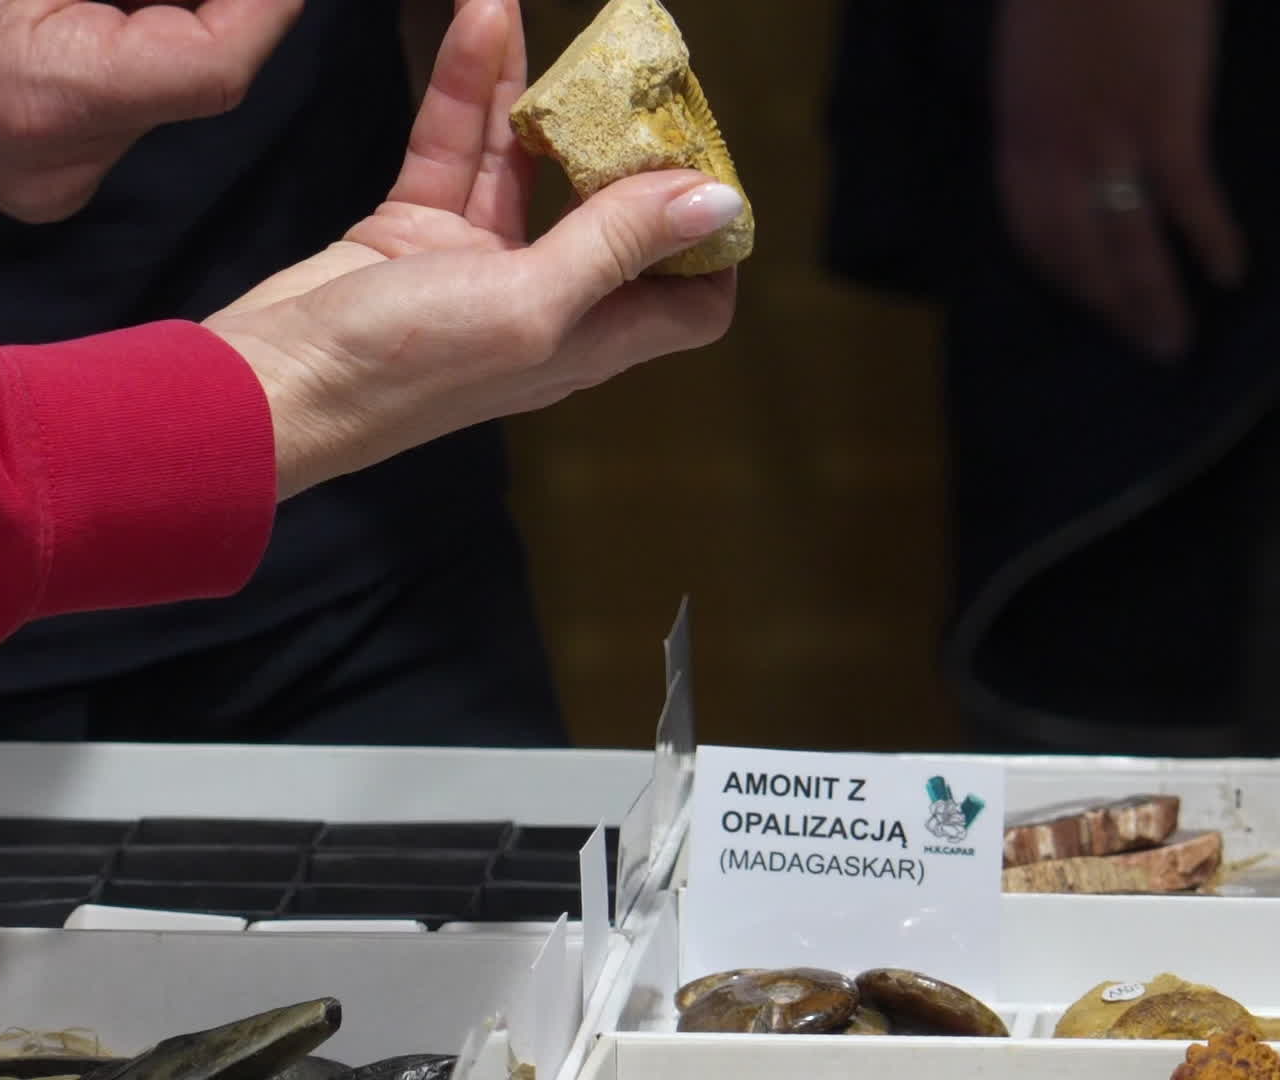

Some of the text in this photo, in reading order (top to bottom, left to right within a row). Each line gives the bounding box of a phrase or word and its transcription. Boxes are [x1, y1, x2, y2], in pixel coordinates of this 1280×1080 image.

[722, 772, 866, 802] AMONIT Z
[721, 810, 908, 848] OPALIZACJĄ
[719, 849, 925, 885] (MADAGASKAR)
